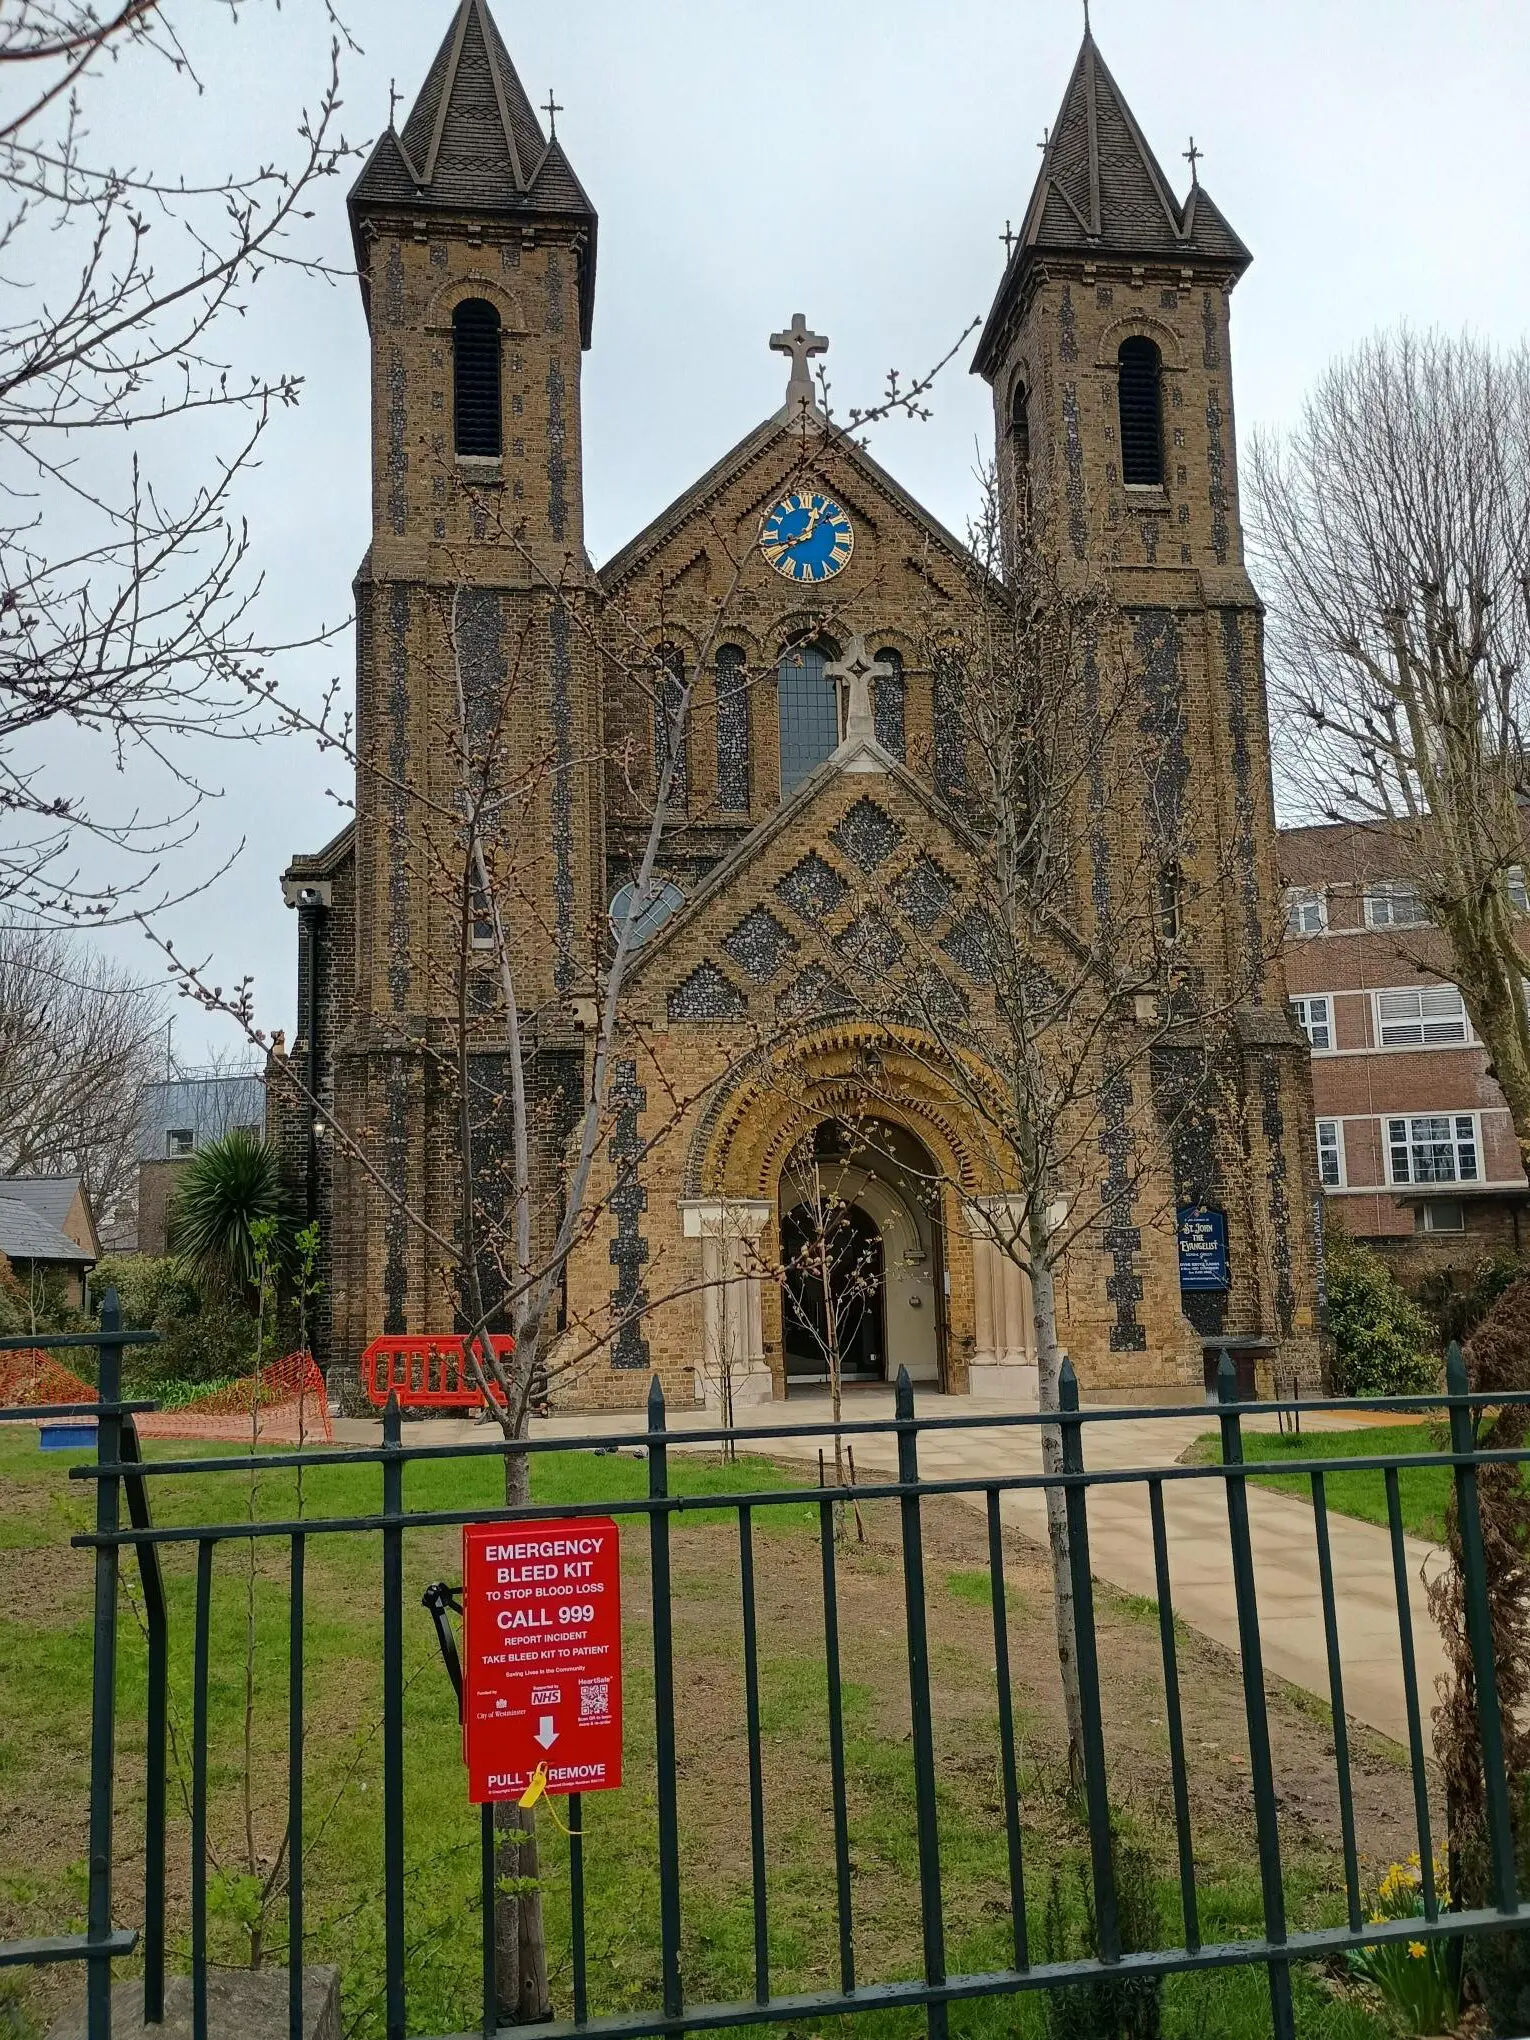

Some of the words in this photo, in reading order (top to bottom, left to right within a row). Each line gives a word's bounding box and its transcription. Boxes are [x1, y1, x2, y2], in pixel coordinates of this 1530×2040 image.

[486, 1538, 604, 1561] EMERGENCY
[497, 1564, 559, 1584] BLEED
[564, 1561, 593, 1578] KIT
[486, 1591, 501, 1601] TO
[504, 1589, 532, 1600] STOP
[536, 1586, 573, 1597] BLOOD
[576, 1583, 604, 1593] LOSS
[497, 1608, 553, 1630] CALL
[559, 1605, 595, 1624] 999
[504, 1635, 542, 1646] REPORT
[544, 1631, 588, 1642] INCIDENT
[482, 1654, 506, 1665] TAKE
[508, 1652, 538, 1661] BLEED
[541, 1650, 556, 1659] KIT
[558, 1649, 571, 1657] TO
[573, 1645, 610, 1656] PATIENT
[533, 1692, 559, 1703] NHS
[477, 1712, 487, 1721] City
[495, 1709, 526, 1718] Westminster
[488, 1772, 523, 1787] PULL
[549, 1764, 606, 1780] REMOVE
